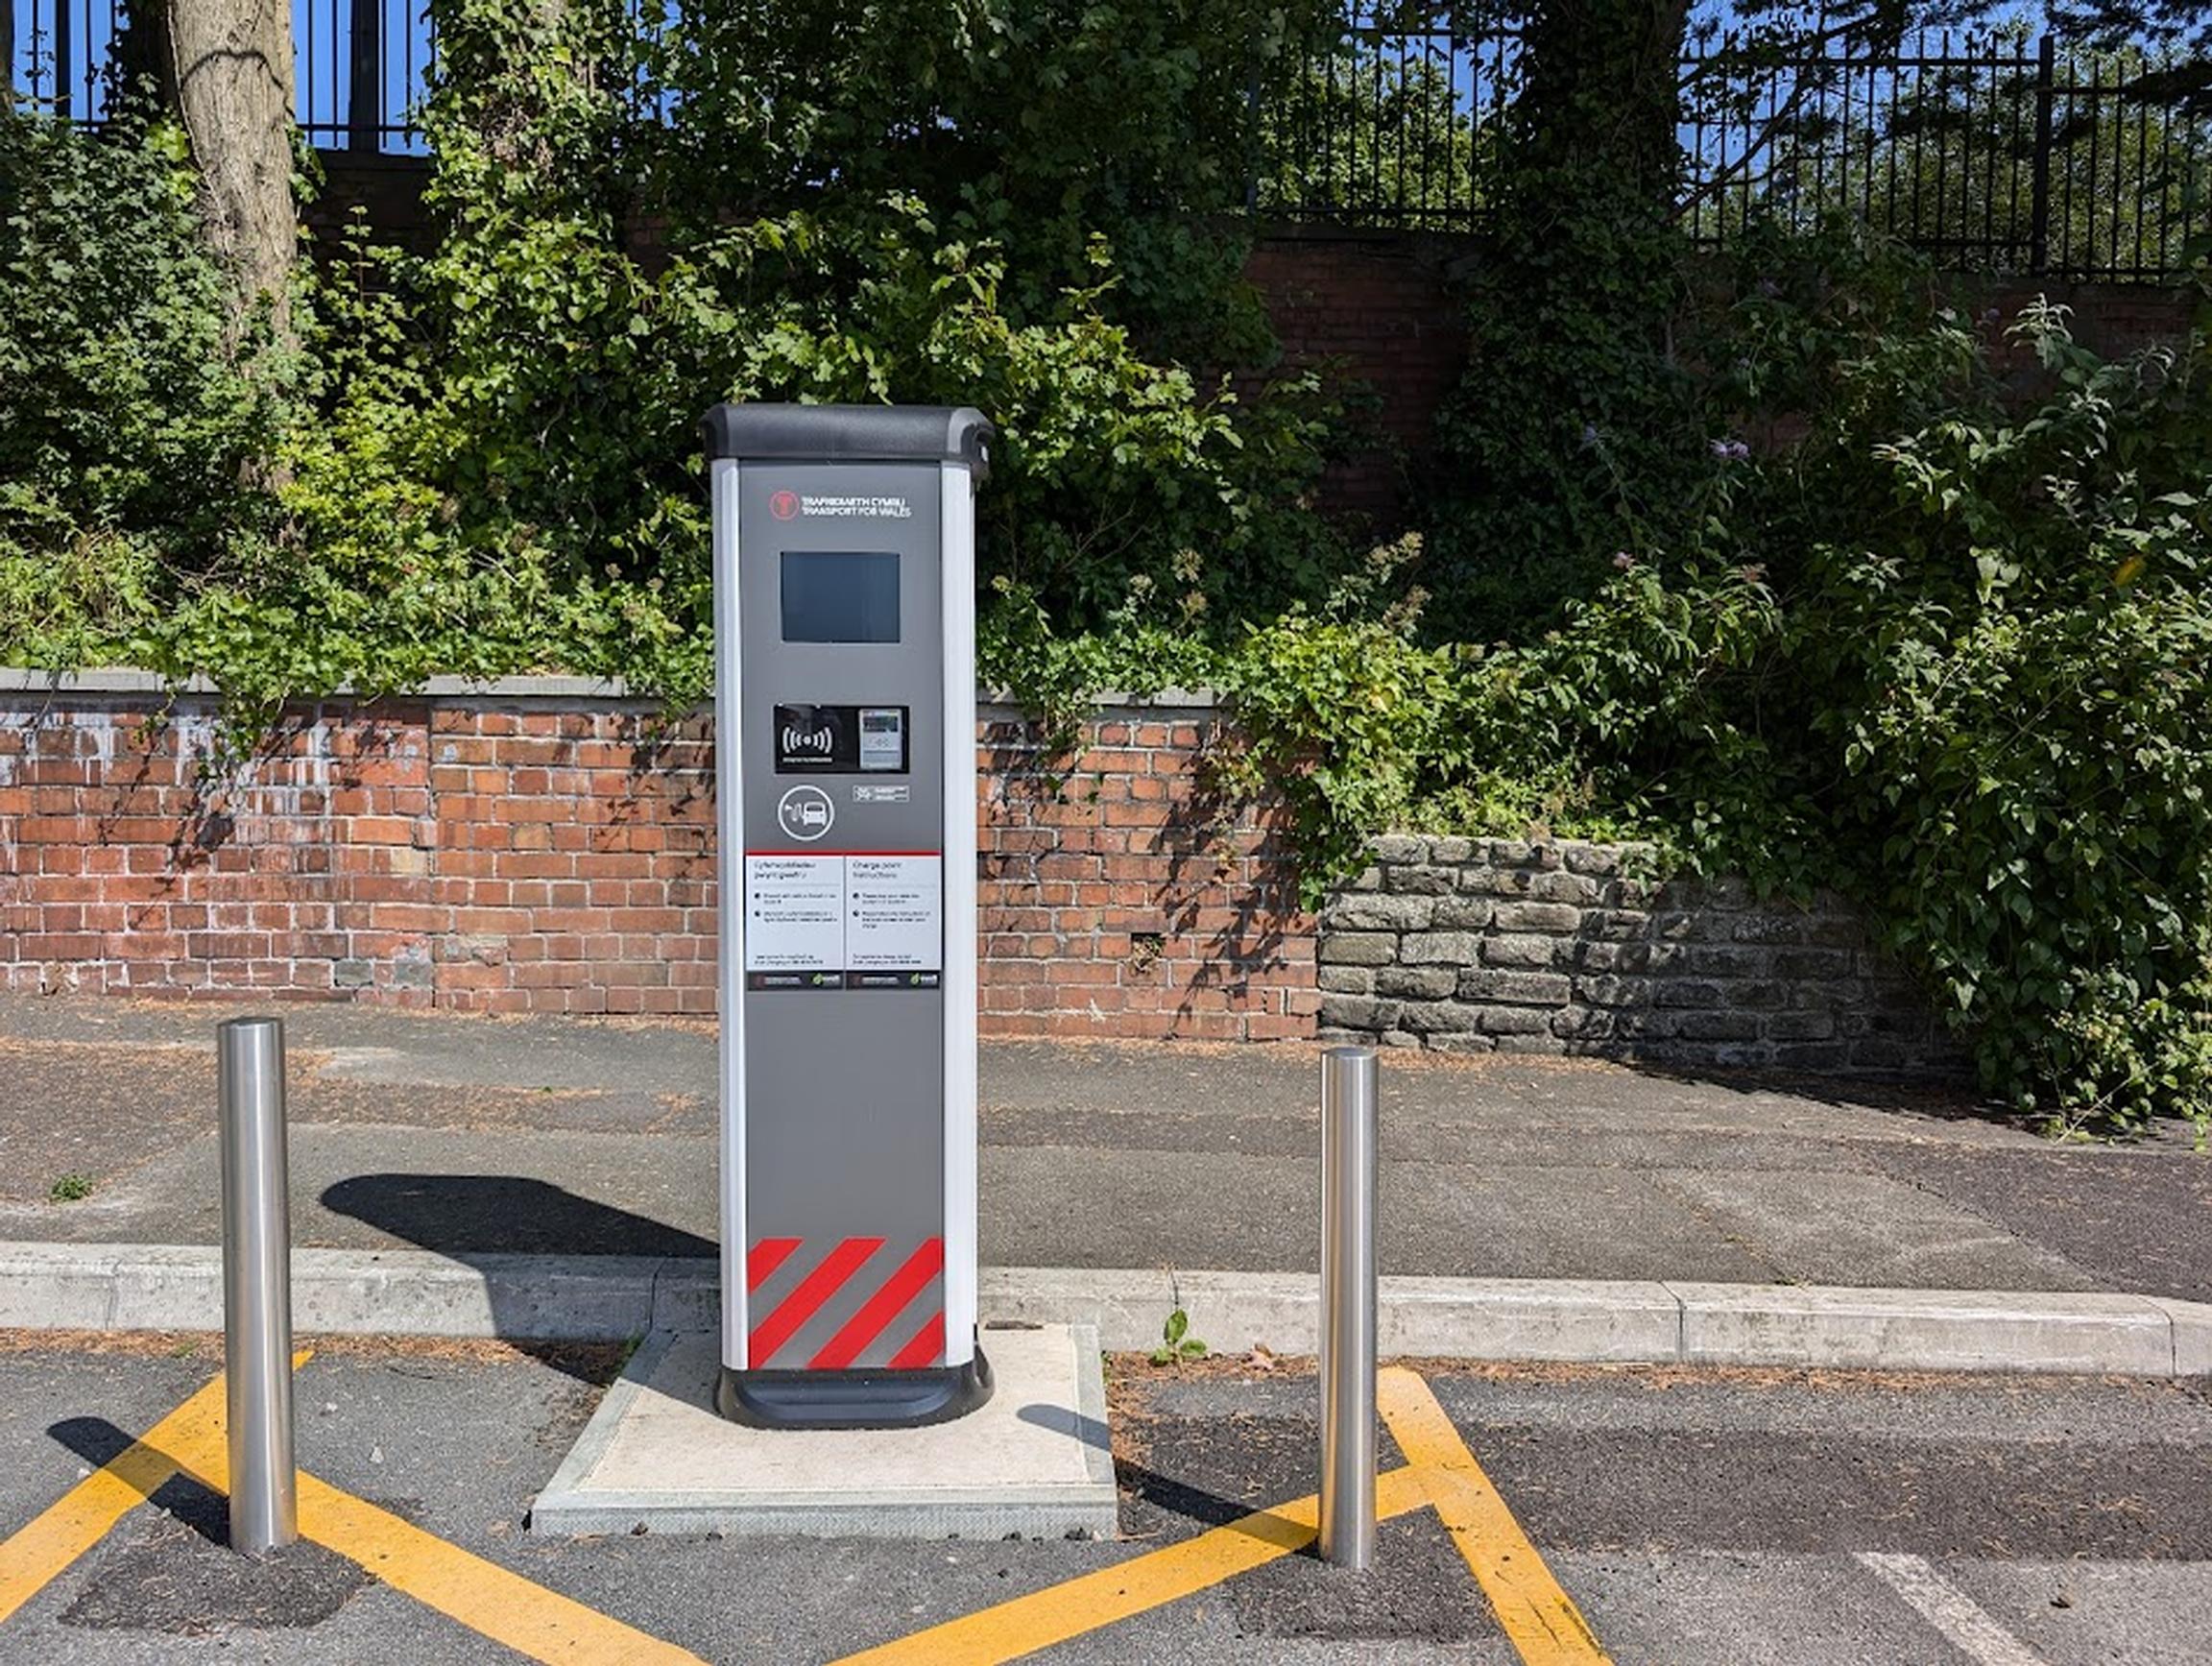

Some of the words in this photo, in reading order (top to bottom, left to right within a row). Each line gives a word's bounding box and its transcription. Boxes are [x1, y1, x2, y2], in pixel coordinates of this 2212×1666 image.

[872, 496, 905, 506] CYMRU
[803, 506, 857, 516] TRANSPORT
[858, 507, 877, 516] FOR
[878, 507, 911, 518] WALES
[853, 860, 880, 870] Charge
